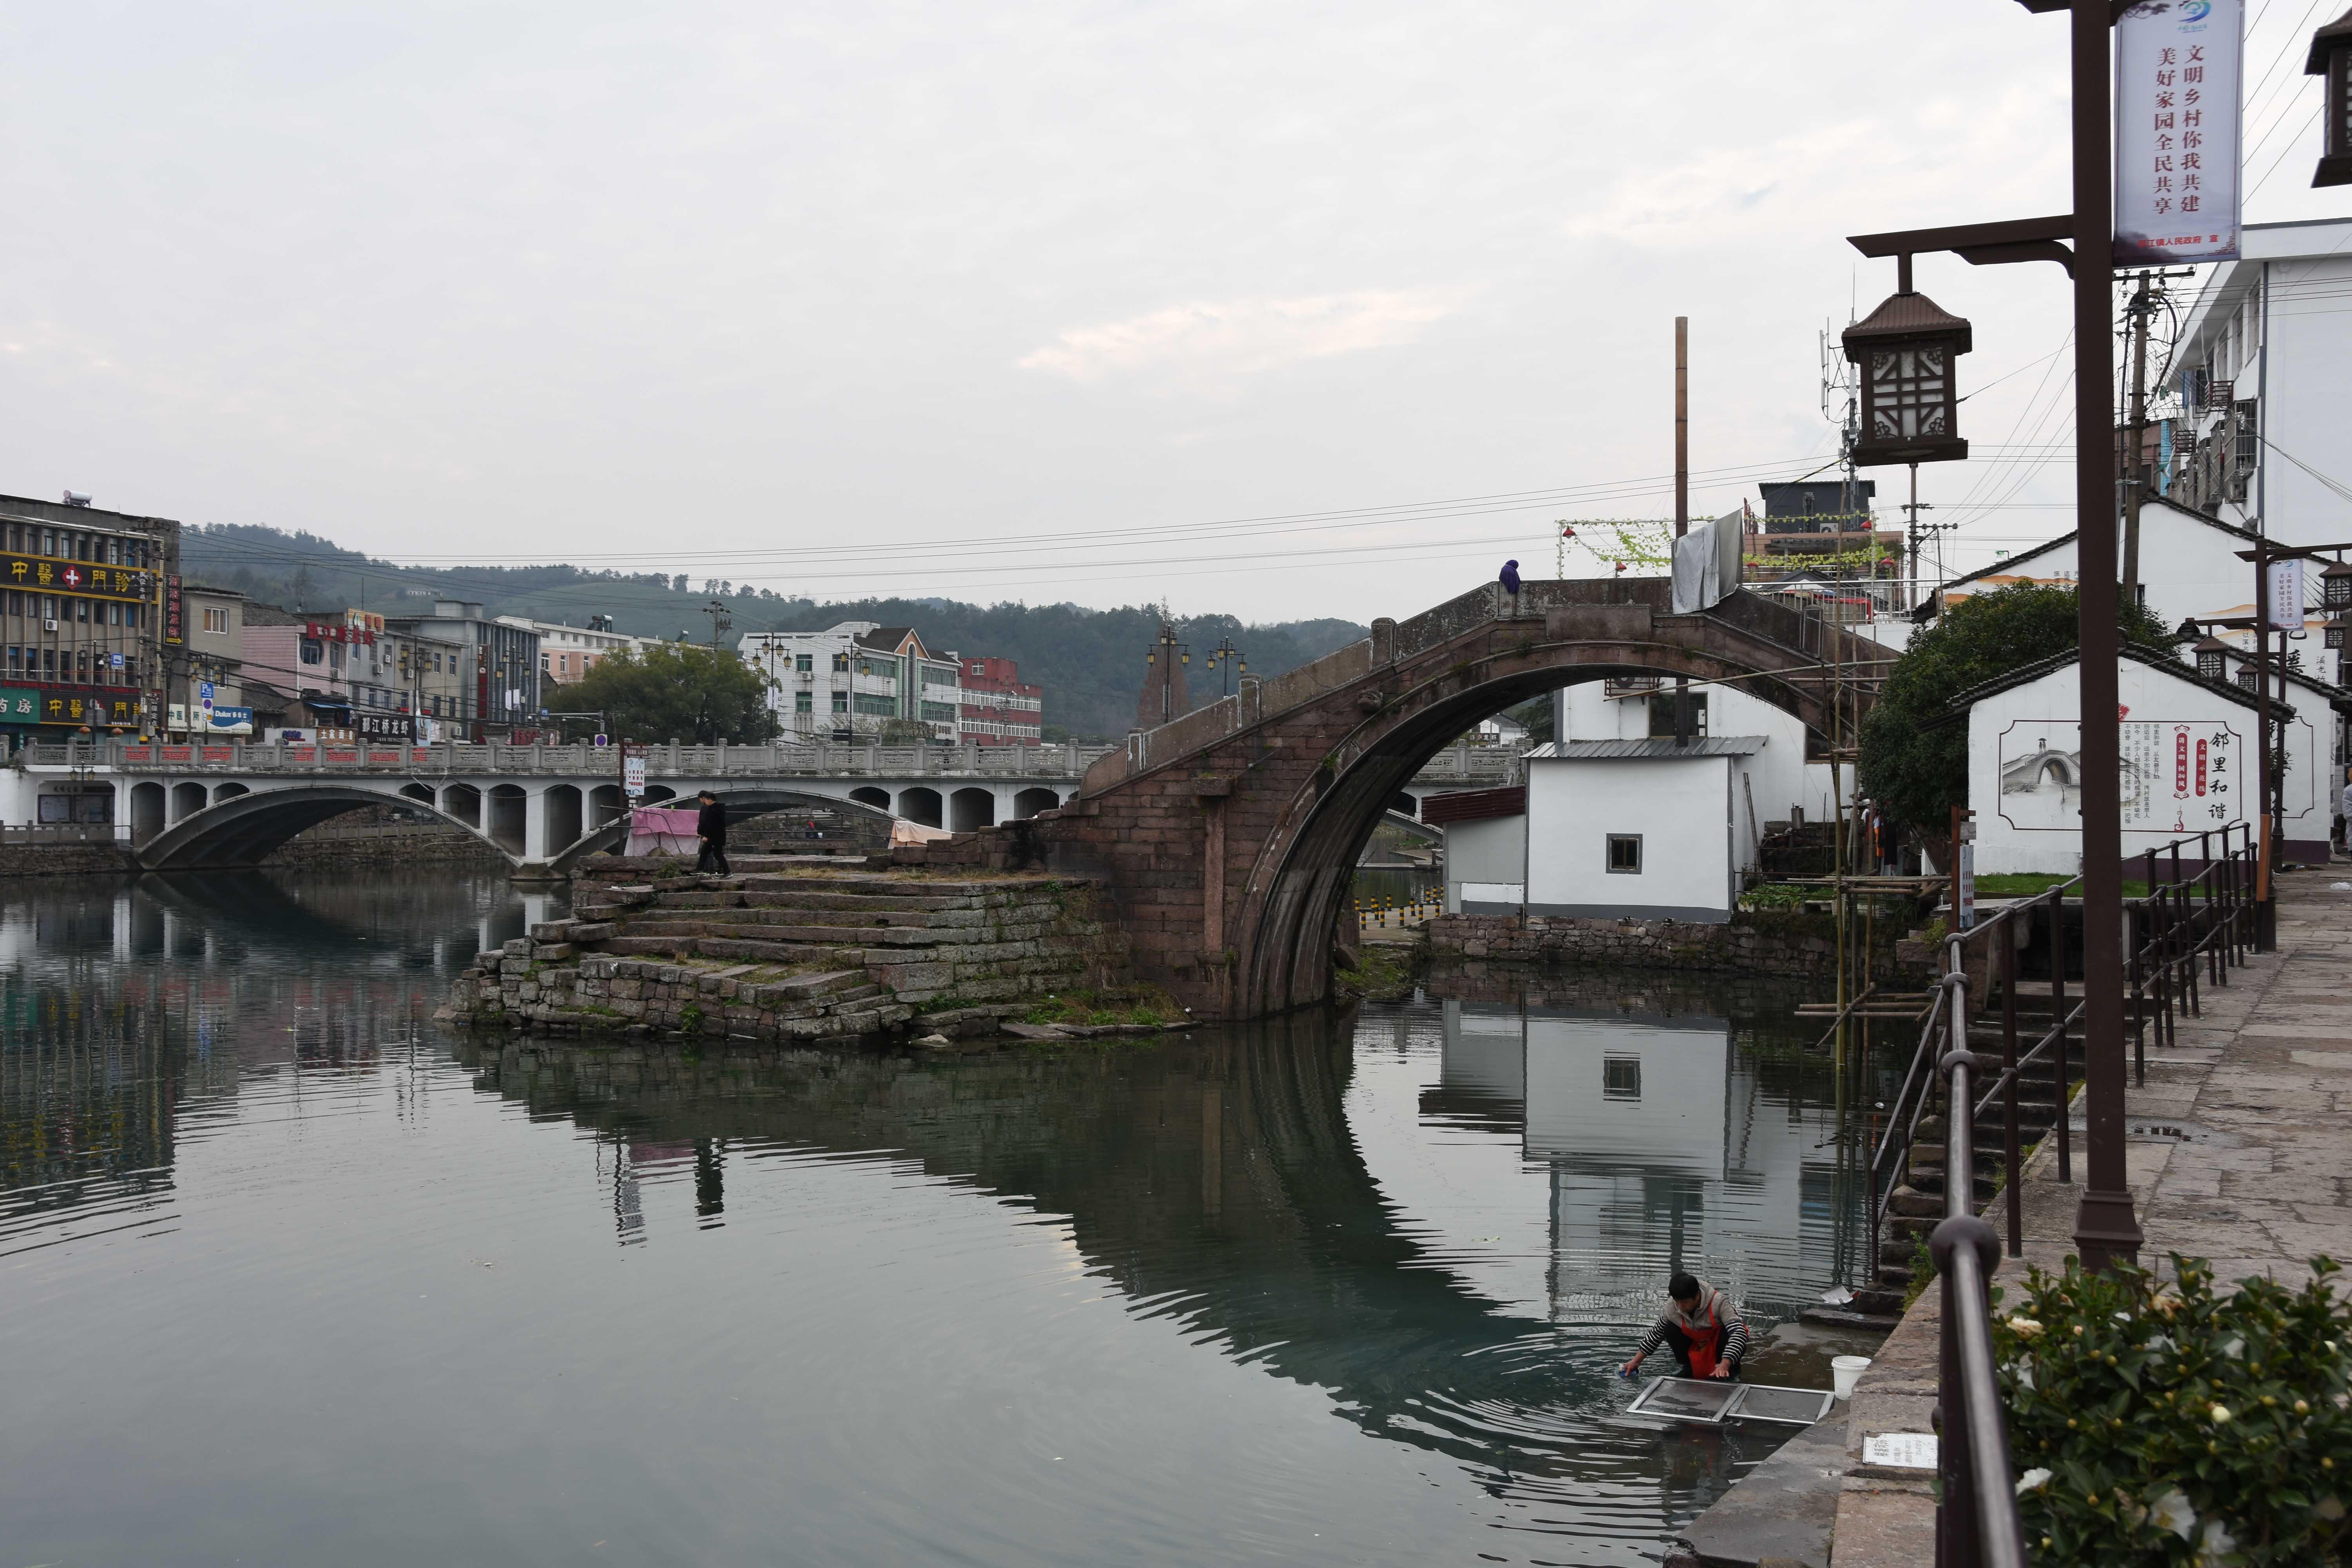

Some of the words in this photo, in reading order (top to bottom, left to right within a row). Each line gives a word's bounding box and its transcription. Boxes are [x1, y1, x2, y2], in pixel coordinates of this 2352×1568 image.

[2152, 47, 2176, 214] 美好家园全民共享
[2180, 45, 2205, 213] 文明乡村你我共建
[2209, 234, 2218, 243] 宣
[11, 561, 53, 586] 中醫
[49, 699, 84, 718] 中醫
[169, 710, 199, 721] 中医所
[362, 717, 409, 736] 鄞江桥龙虾
[2208, 732, 2229, 820] 邻里和谐
